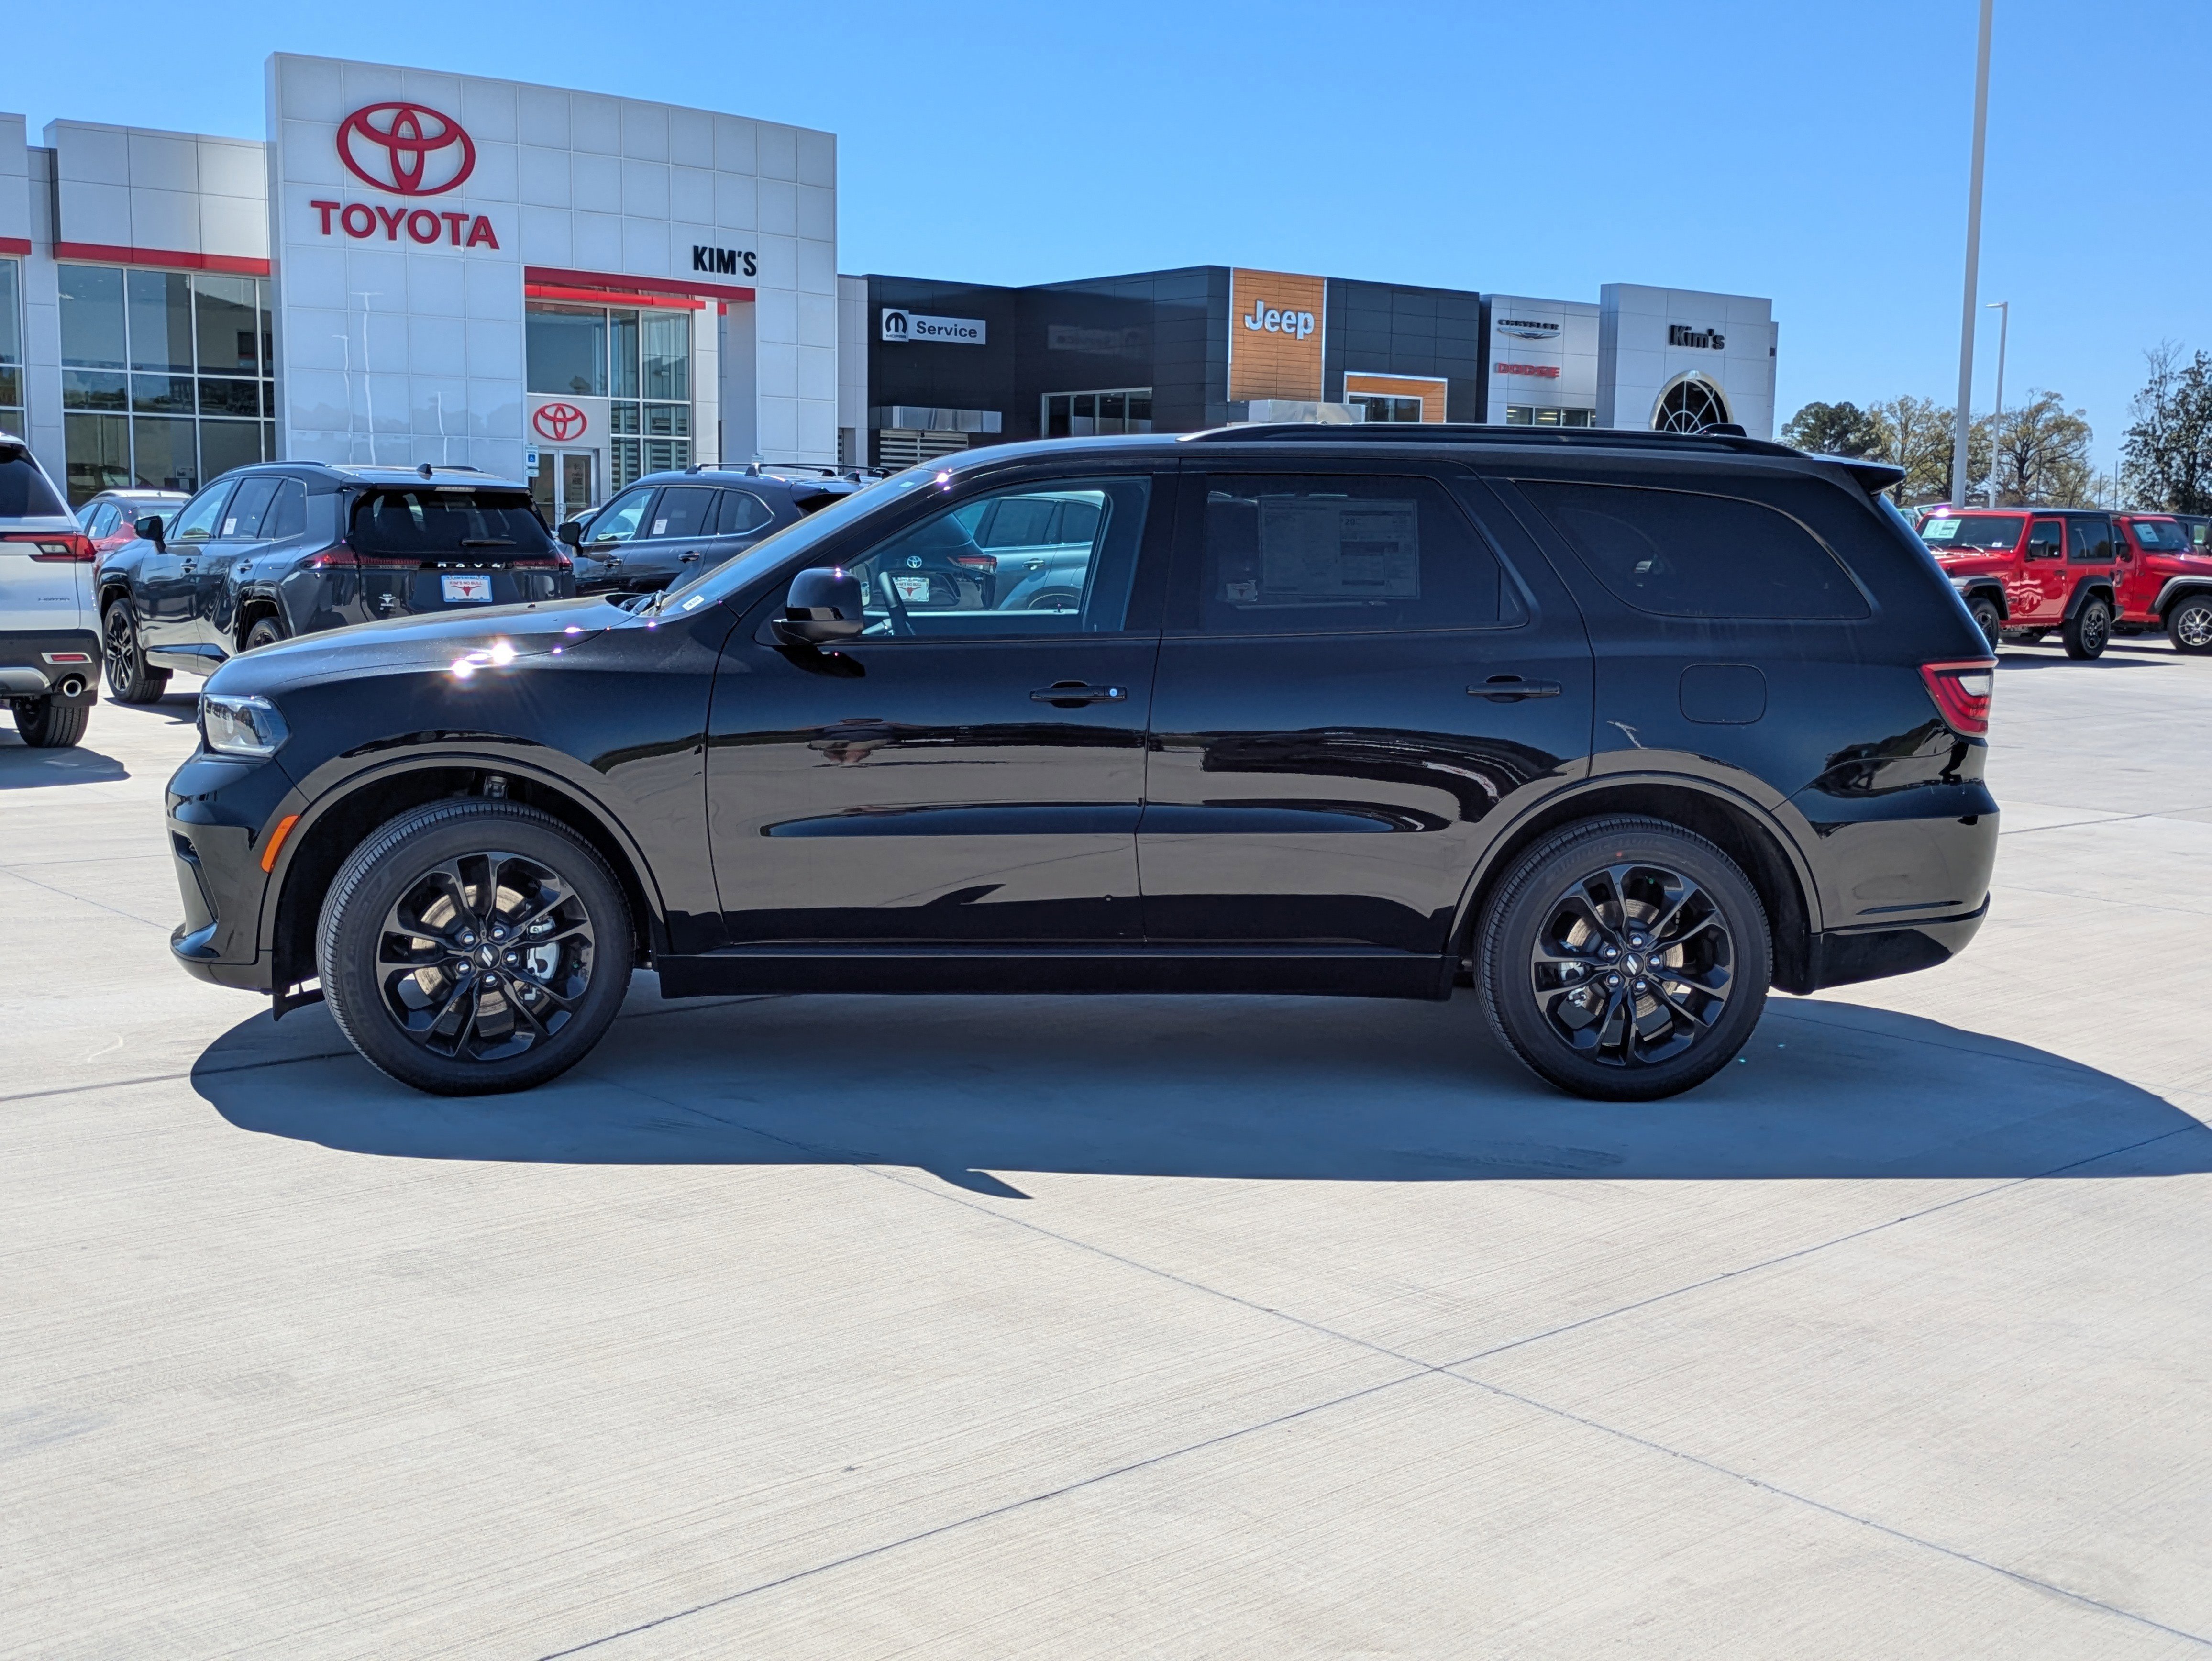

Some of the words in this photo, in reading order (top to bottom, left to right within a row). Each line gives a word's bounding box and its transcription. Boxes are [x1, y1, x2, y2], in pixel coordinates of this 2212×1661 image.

[310, 200, 500, 250] TOYOTA
[693, 245, 756, 277] KIM'S
[916, 321, 977, 338] Service
[1244, 299, 1315, 340] Jeep
[1670, 324, 1725, 350] Kim's
[1495, 362, 1560, 378] DODGE
